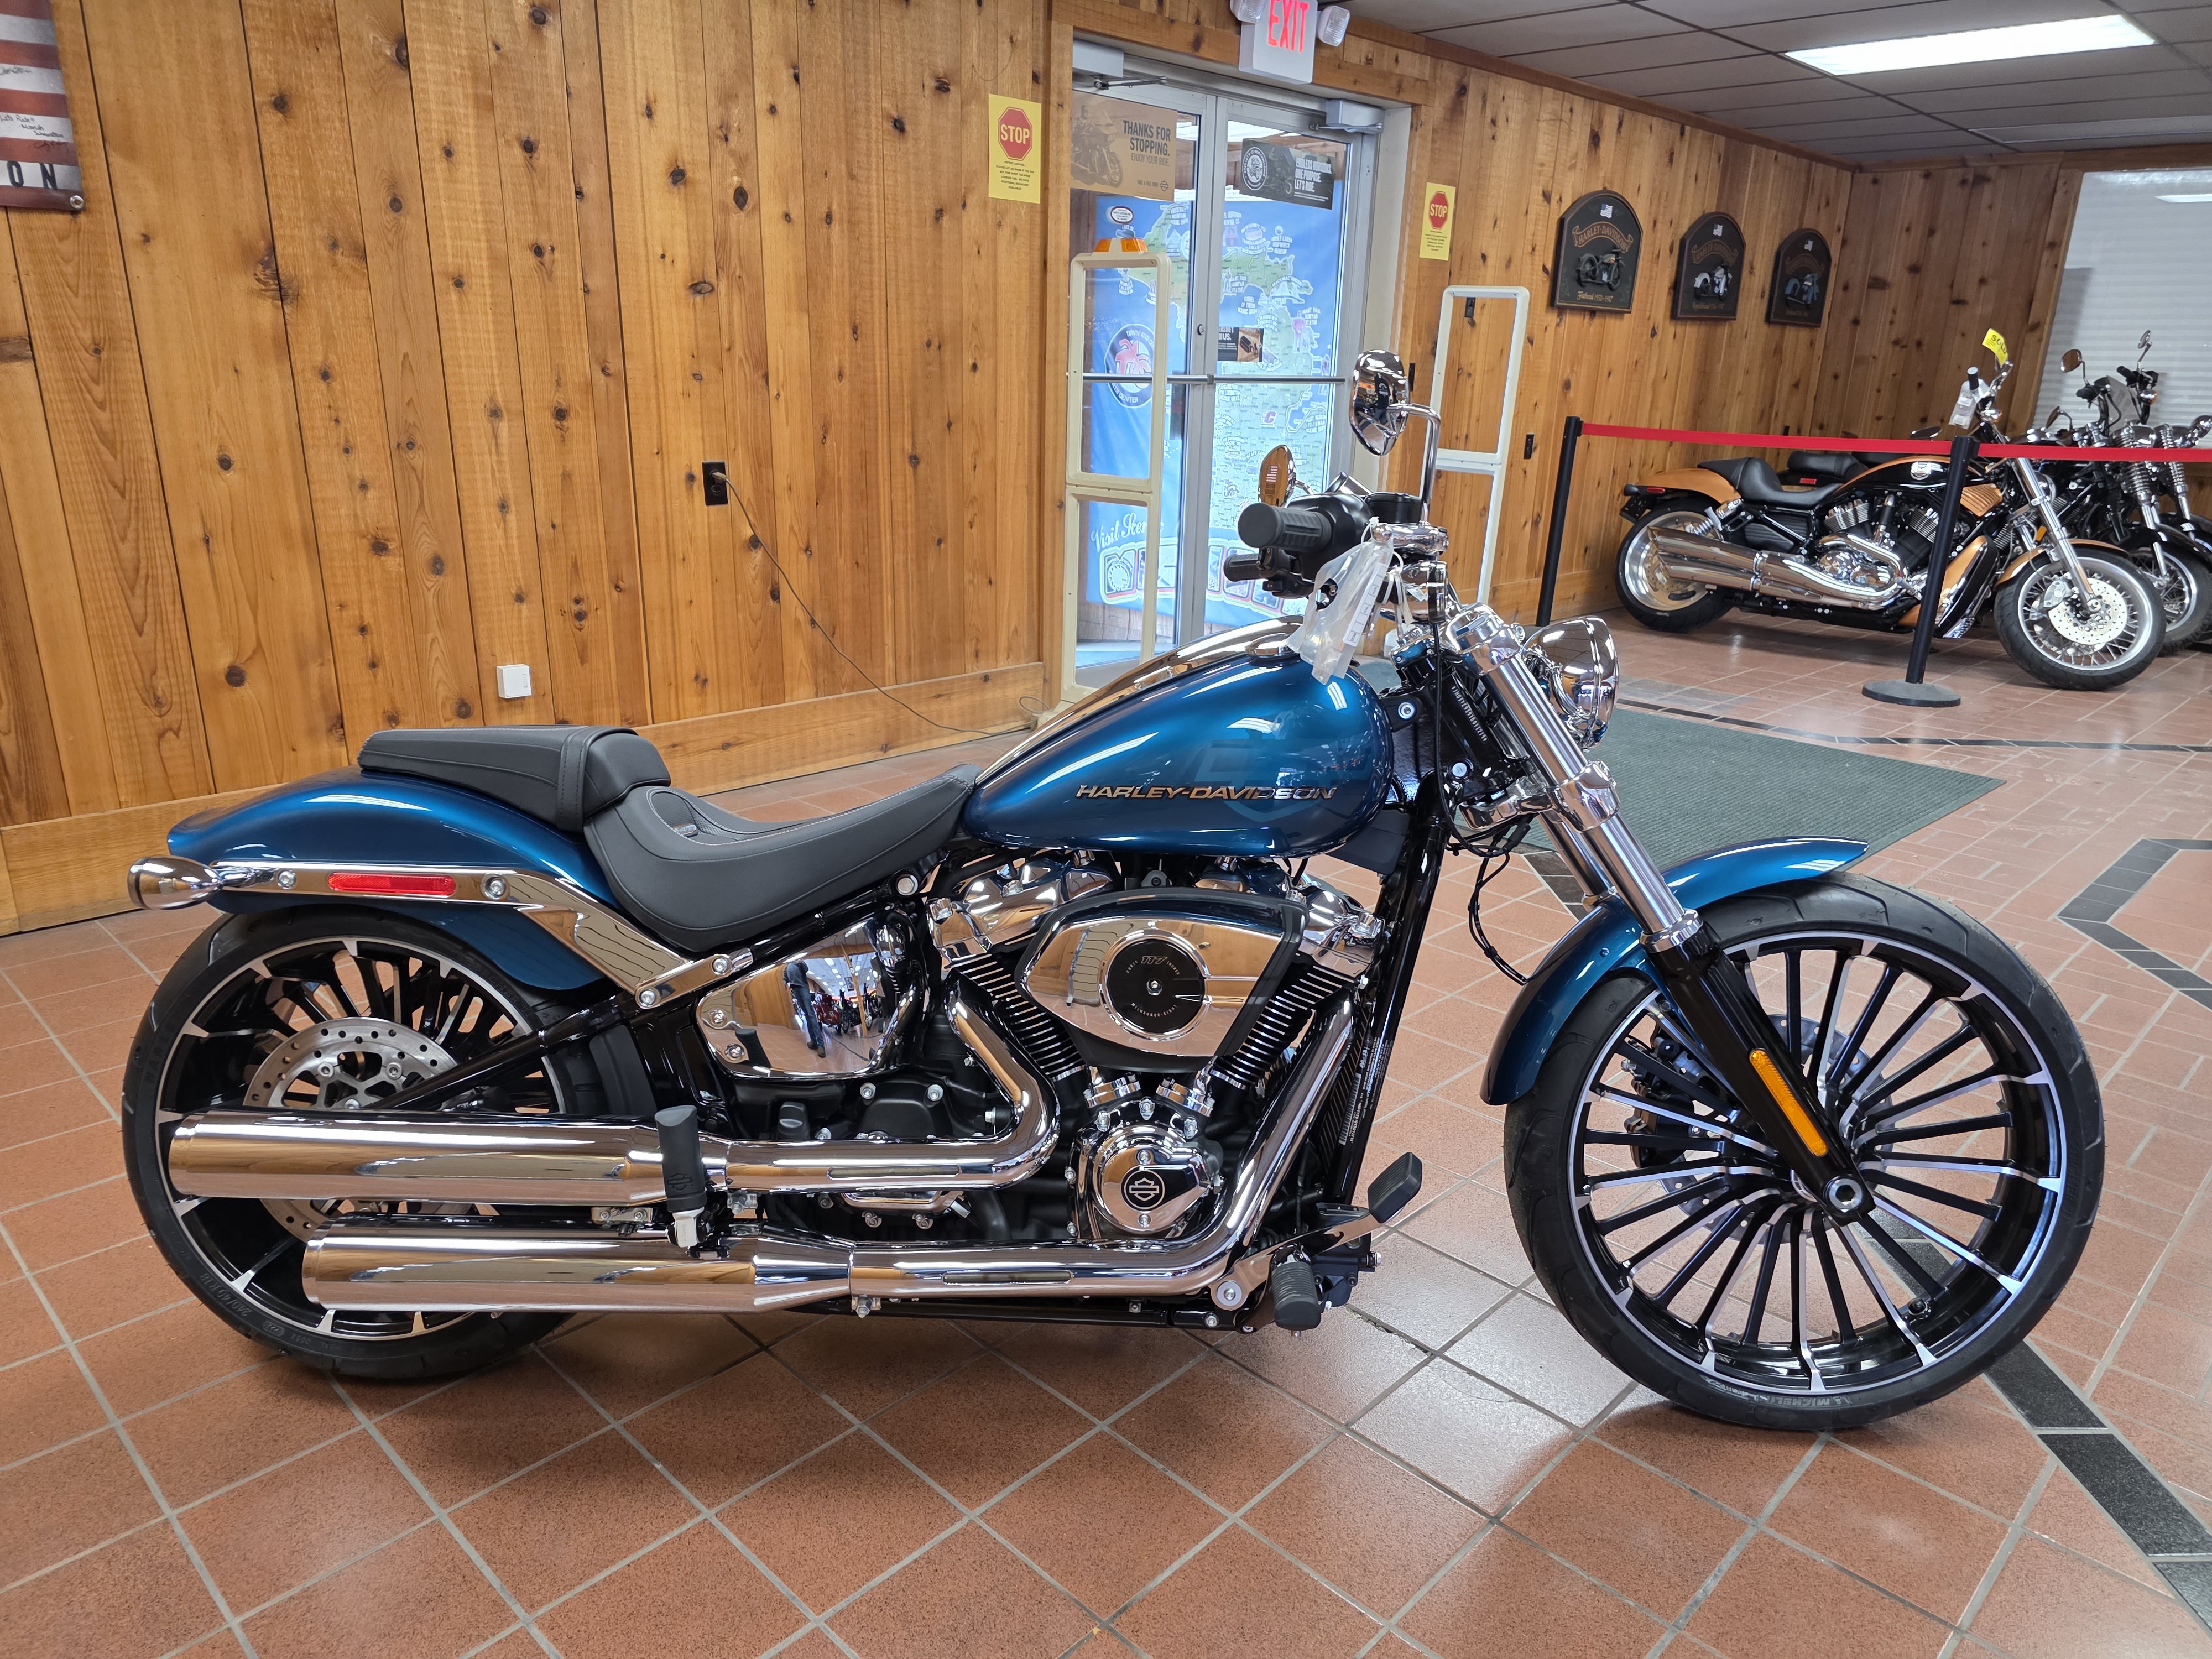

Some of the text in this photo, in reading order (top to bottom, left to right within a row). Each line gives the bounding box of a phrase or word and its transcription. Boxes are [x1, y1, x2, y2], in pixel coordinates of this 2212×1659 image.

[1268, 0, 1310, 53] EXIT
[1000, 124, 1030, 144] STOP
[1123, 119, 1171, 142] THANKS FOR
[1130, 137, 1170, 156] STOPPING.
[1131, 153, 1170, 166] ENJOY YOUR RIDE.
[1430, 204, 1447, 218] STOP
[1091, 520, 1120, 552] Visit
[1076, 785, 1337, 800] HARLEY-DAVIDSON
[1126, 956, 1180, 975] CUBIC 117 INCHES
[1131, 1003, 1177, 1018] MILWAUKEE-EIGHT
[216, 1288, 252, 1317] 240/40
[1759, 1394, 1830, 1407] MICHELIN
